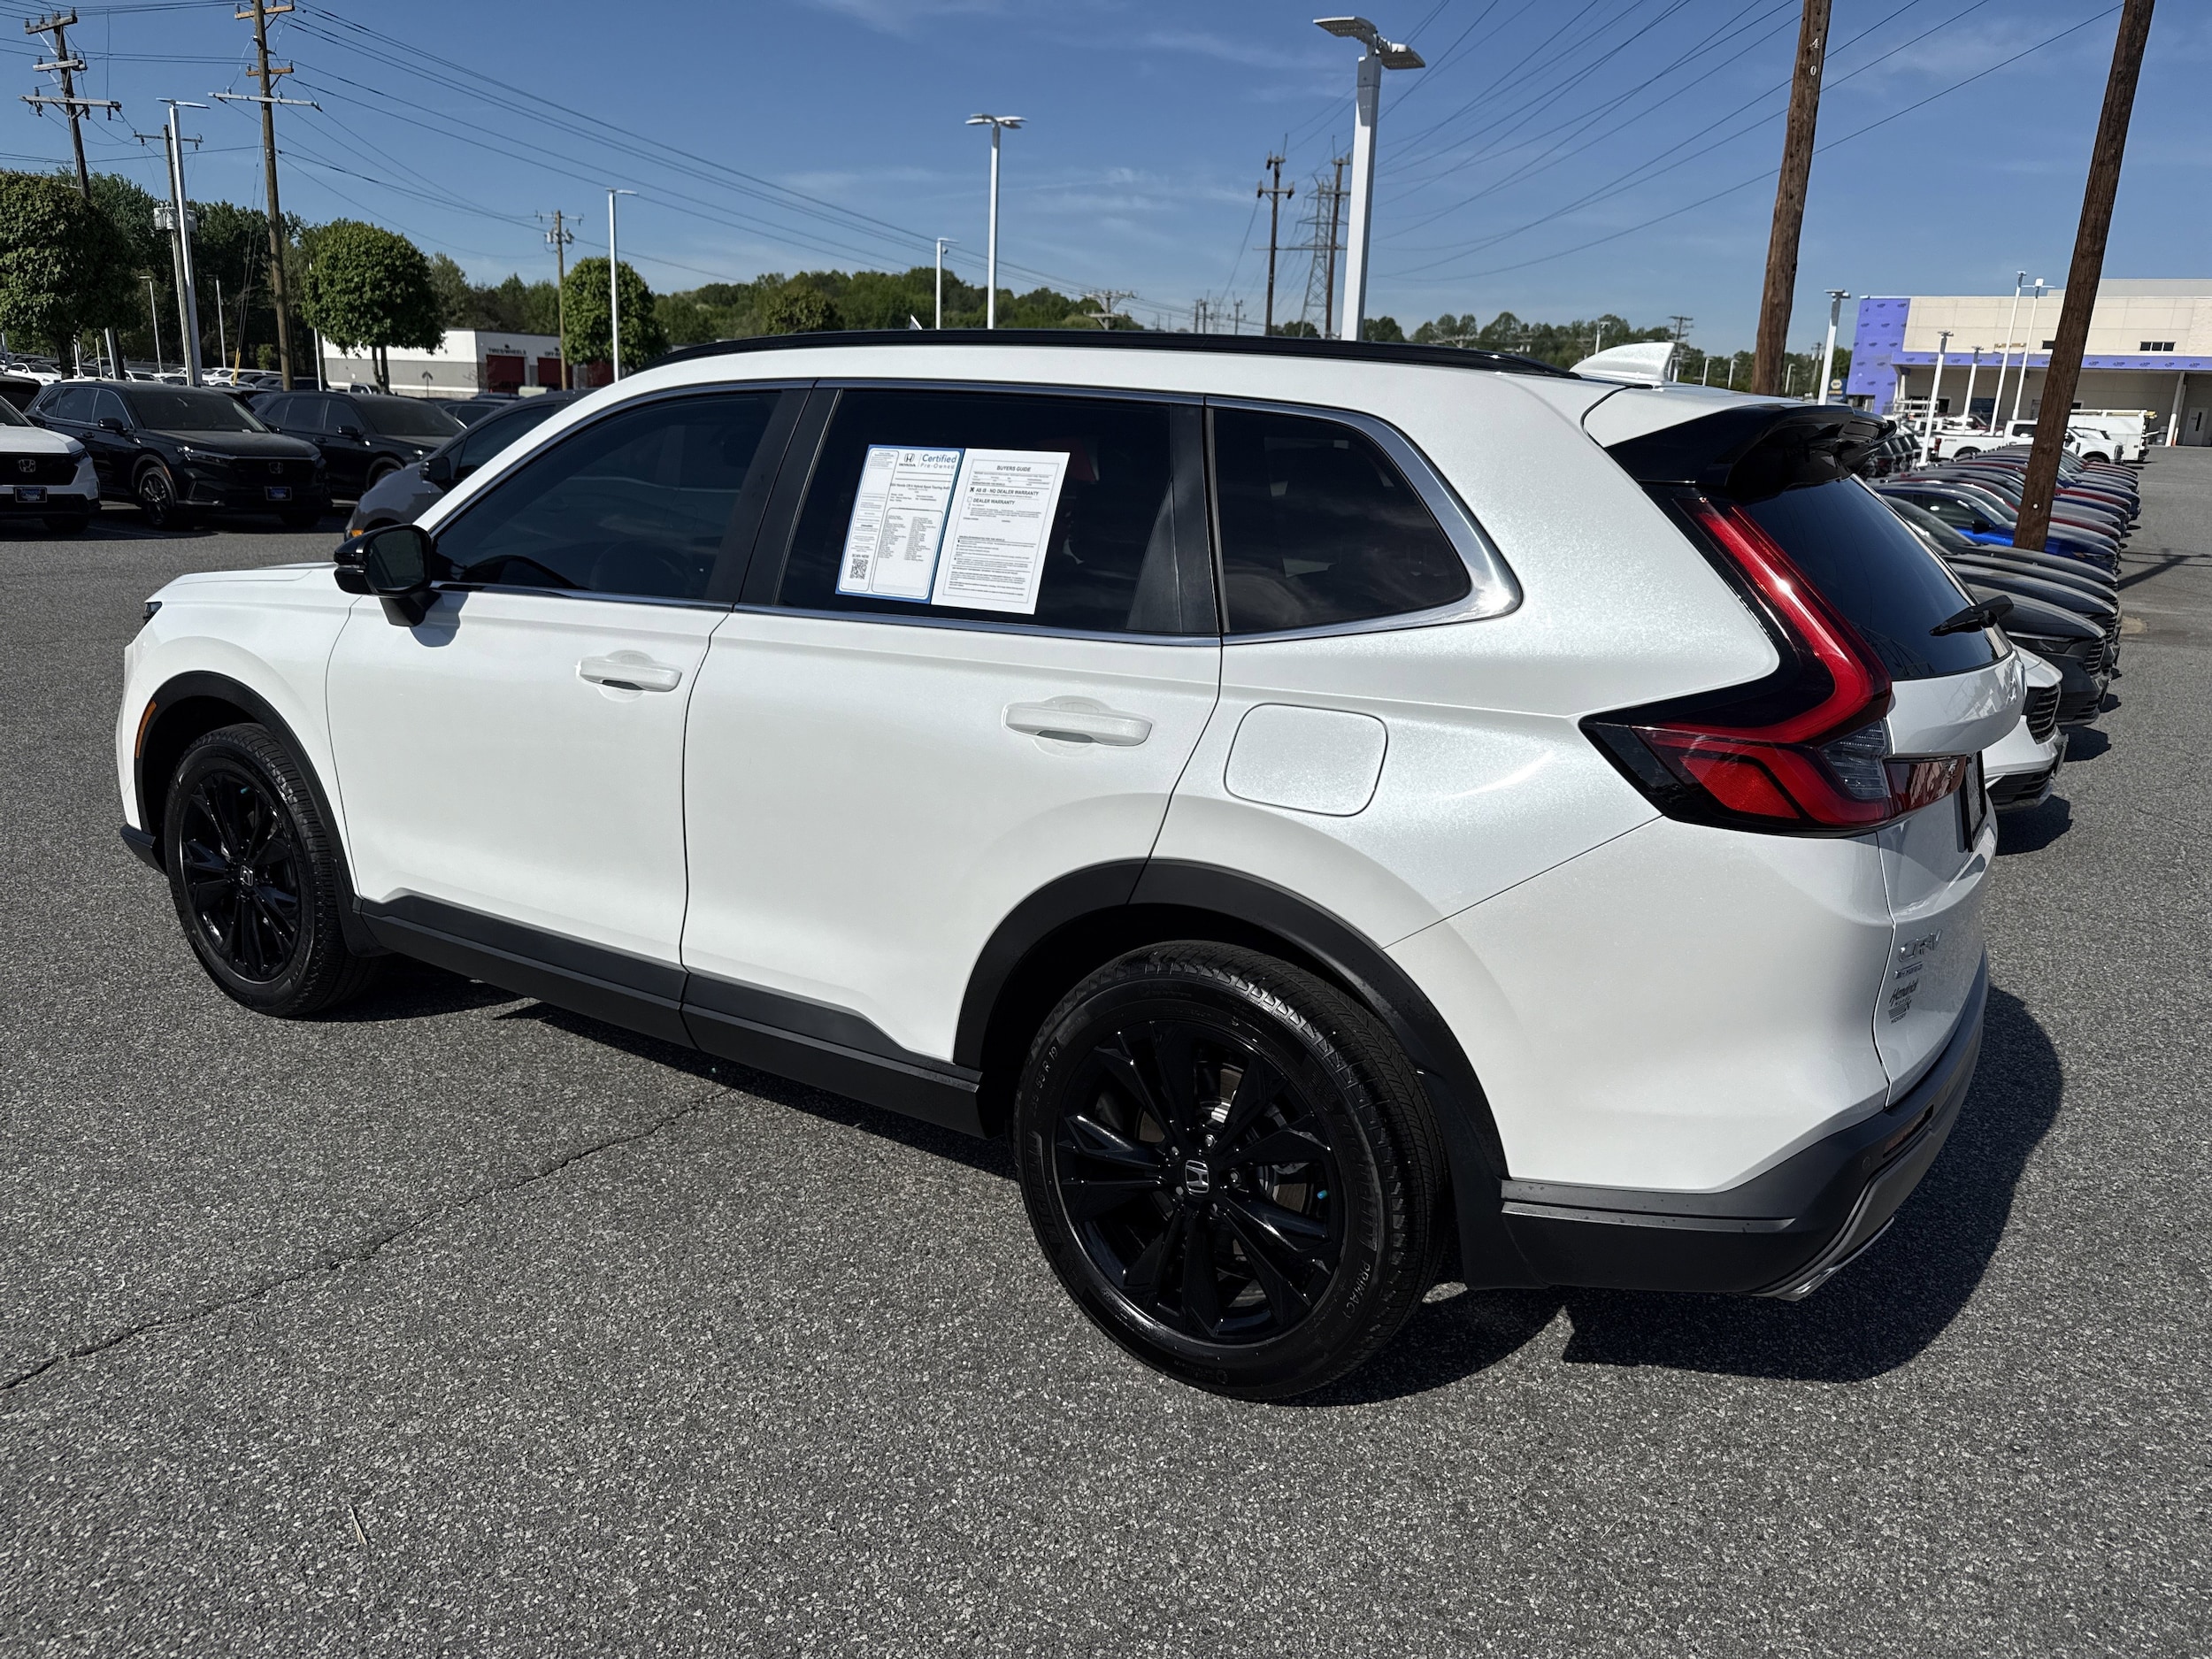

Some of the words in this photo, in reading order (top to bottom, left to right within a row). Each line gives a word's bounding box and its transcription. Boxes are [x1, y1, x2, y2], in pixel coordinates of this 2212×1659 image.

[922, 453, 957, 464] Certified
[1048, 1046, 1058, 1060] 19
[1342, 1259, 1371, 1319] PRIMACY
